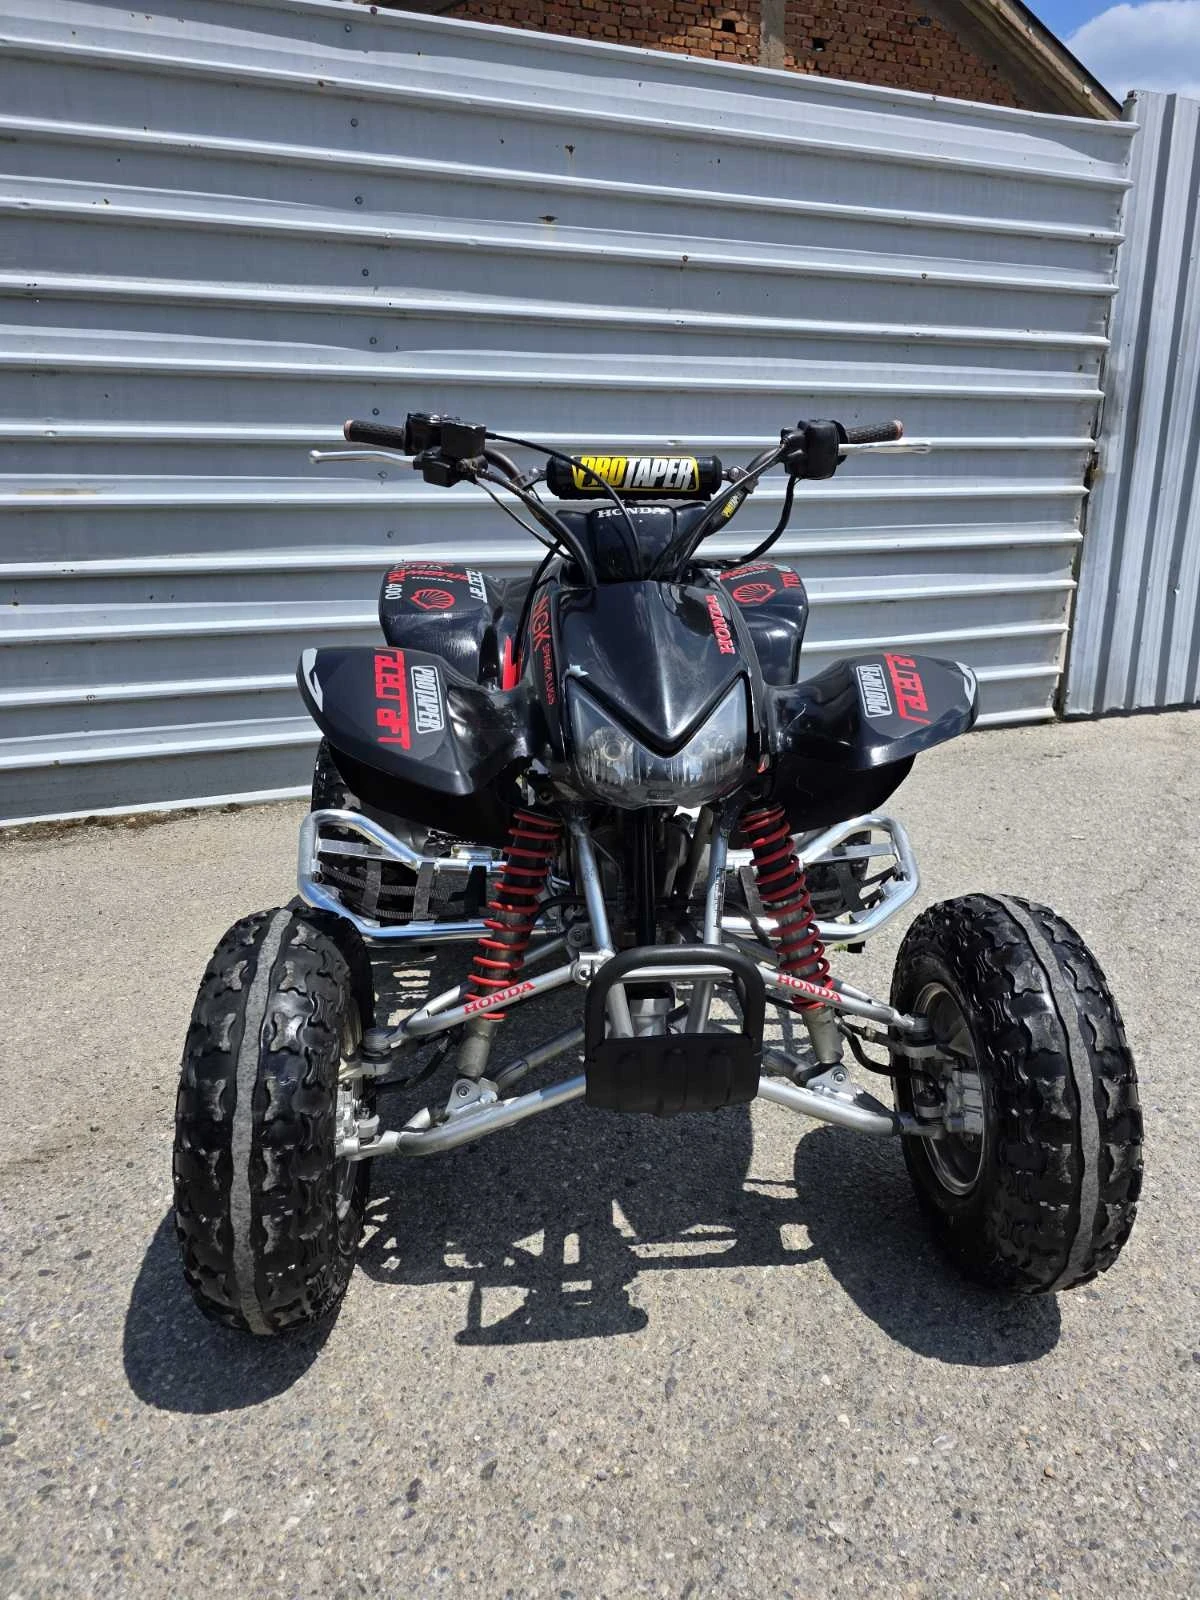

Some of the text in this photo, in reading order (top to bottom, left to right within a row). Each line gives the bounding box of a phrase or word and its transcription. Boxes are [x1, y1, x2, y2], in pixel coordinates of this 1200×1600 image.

[574, 456, 693, 490] PROTAPER
[598, 507, 671, 518] HONDA
[384, 583, 403, 600] 400
[533, 595, 552, 652] NGK
[704, 595, 736, 655] HONDA
[413, 665, 443, 731] PROTAPER
[858, 664, 892, 716] PROTAPER
[464, 981, 536, 1014] HONDA
[777, 973, 842, 1003] HONDA
